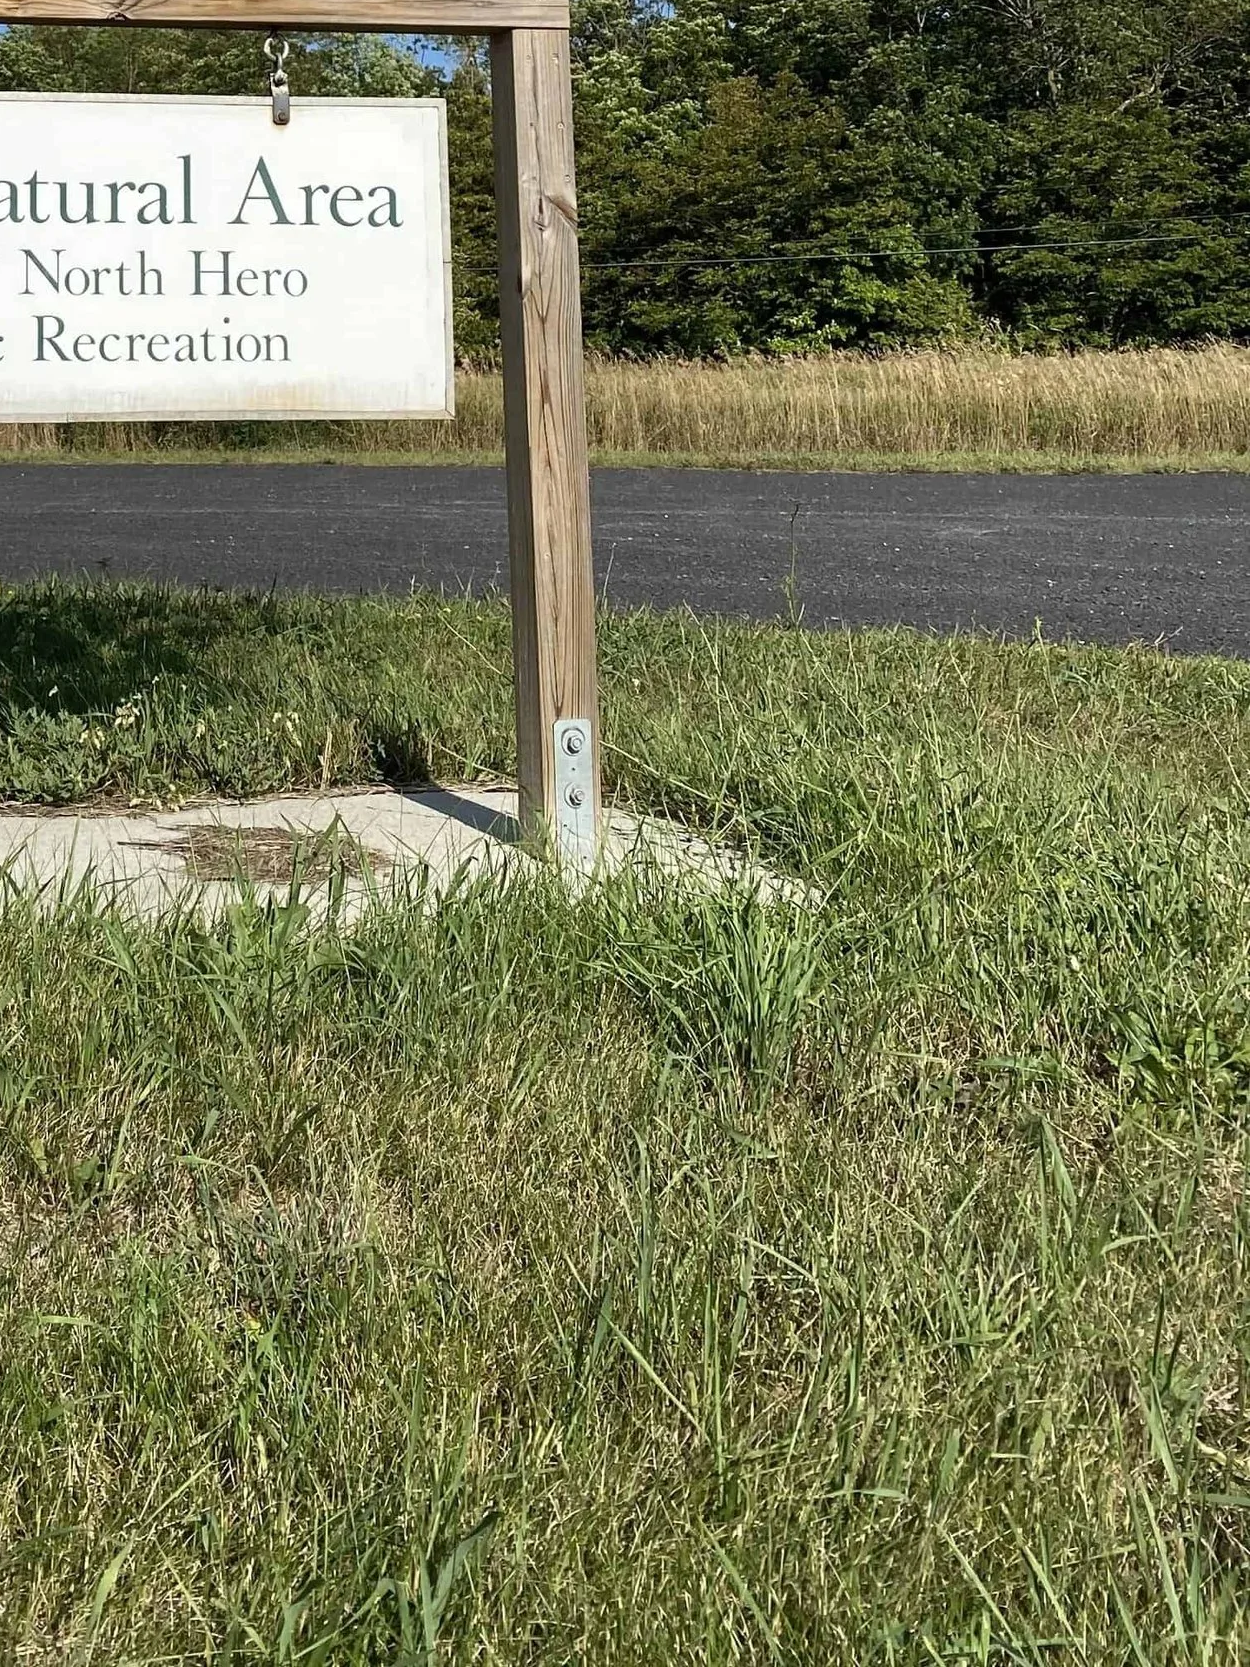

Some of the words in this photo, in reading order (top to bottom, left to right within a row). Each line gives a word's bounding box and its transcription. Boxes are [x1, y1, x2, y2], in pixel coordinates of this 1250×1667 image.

[227, 156, 404, 228] Area
[21, 249, 164, 297] North
[190, 250, 309, 298] Hero
[32, 315, 292, 363] Recreation
